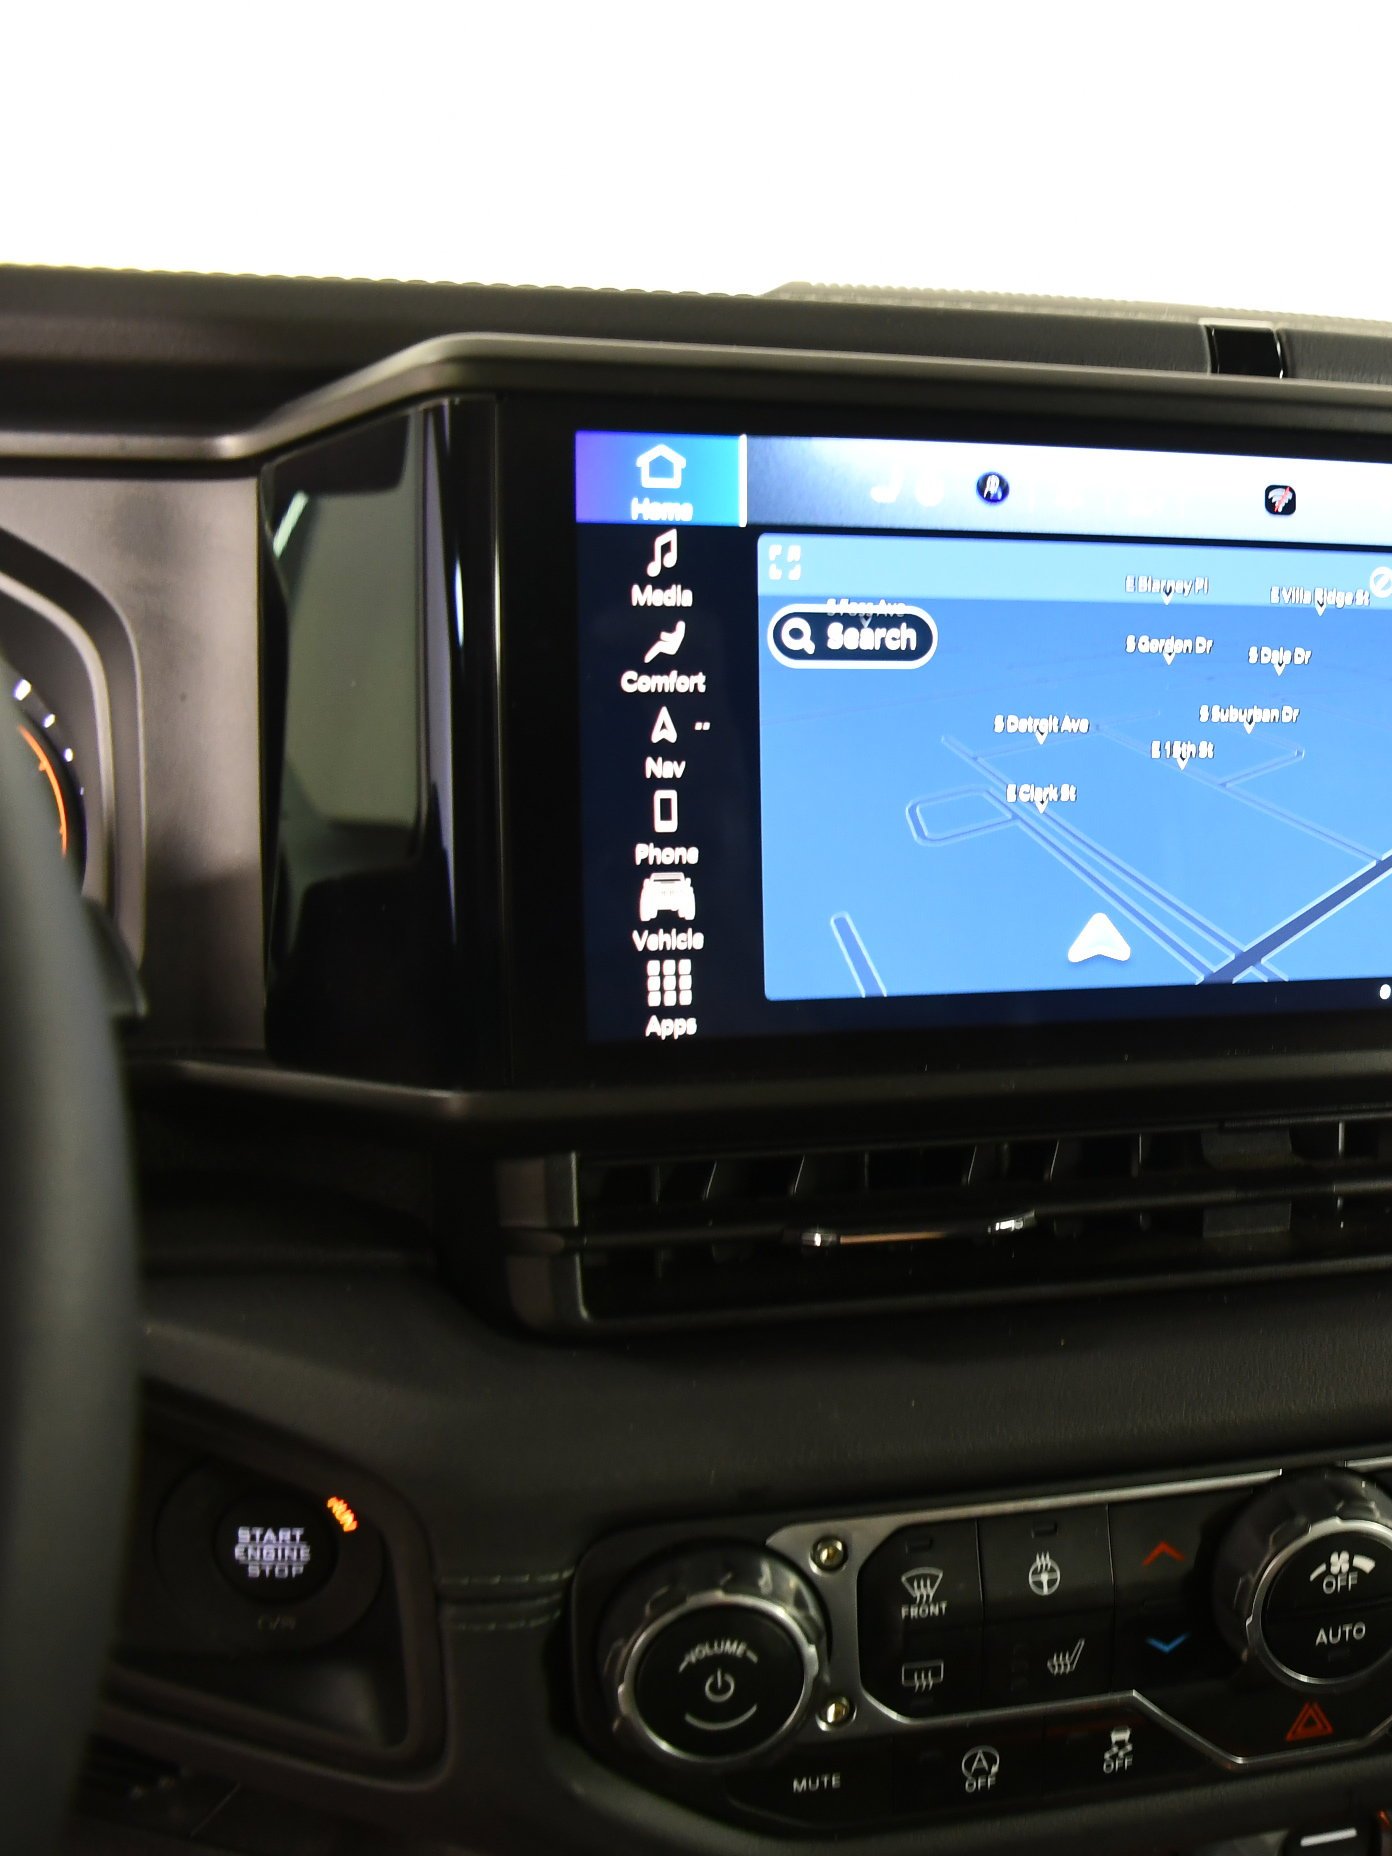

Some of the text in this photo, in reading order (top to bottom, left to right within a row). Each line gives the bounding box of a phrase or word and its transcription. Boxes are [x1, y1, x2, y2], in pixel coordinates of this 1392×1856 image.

[631, 498, 693, 521] Home
[631, 584, 693, 607] Media
[827, 622, 917, 651] Search
[1138, 635, 1193, 653] Gordon
[1195, 636, 1214, 654] Dr
[1294, 647, 1312, 664] Dr
[621, 670, 706, 693] Comfort
[1006, 715, 1059, 733] Detroit
[1061, 716, 1090, 733] Ave
[1211, 704, 1279, 724] Suburban
[1281, 706, 1299, 723] Dr
[1199, 741, 1214, 758] St
[645, 757, 686, 778] Nav
[1060, 785, 1077, 802] St
[635, 843, 699, 865] Phone
[632, 928, 704, 951] Vehicle
[645, 1015, 697, 1040] Apps
[238, 1526, 304, 1544] START
[234, 1543, 310, 1565] ENGINE
[247, 1562, 304, 1579] STOP
[1322, 1572, 1359, 1595] OFF
[901, 1602, 947, 1619] FRONT
[1315, 1621, 1366, 1646] AUTO
[1102, 1754, 1134, 1774] OFF
[792, 1773, 841, 1793] MUTE
[965, 1775, 997, 1793] OFF
